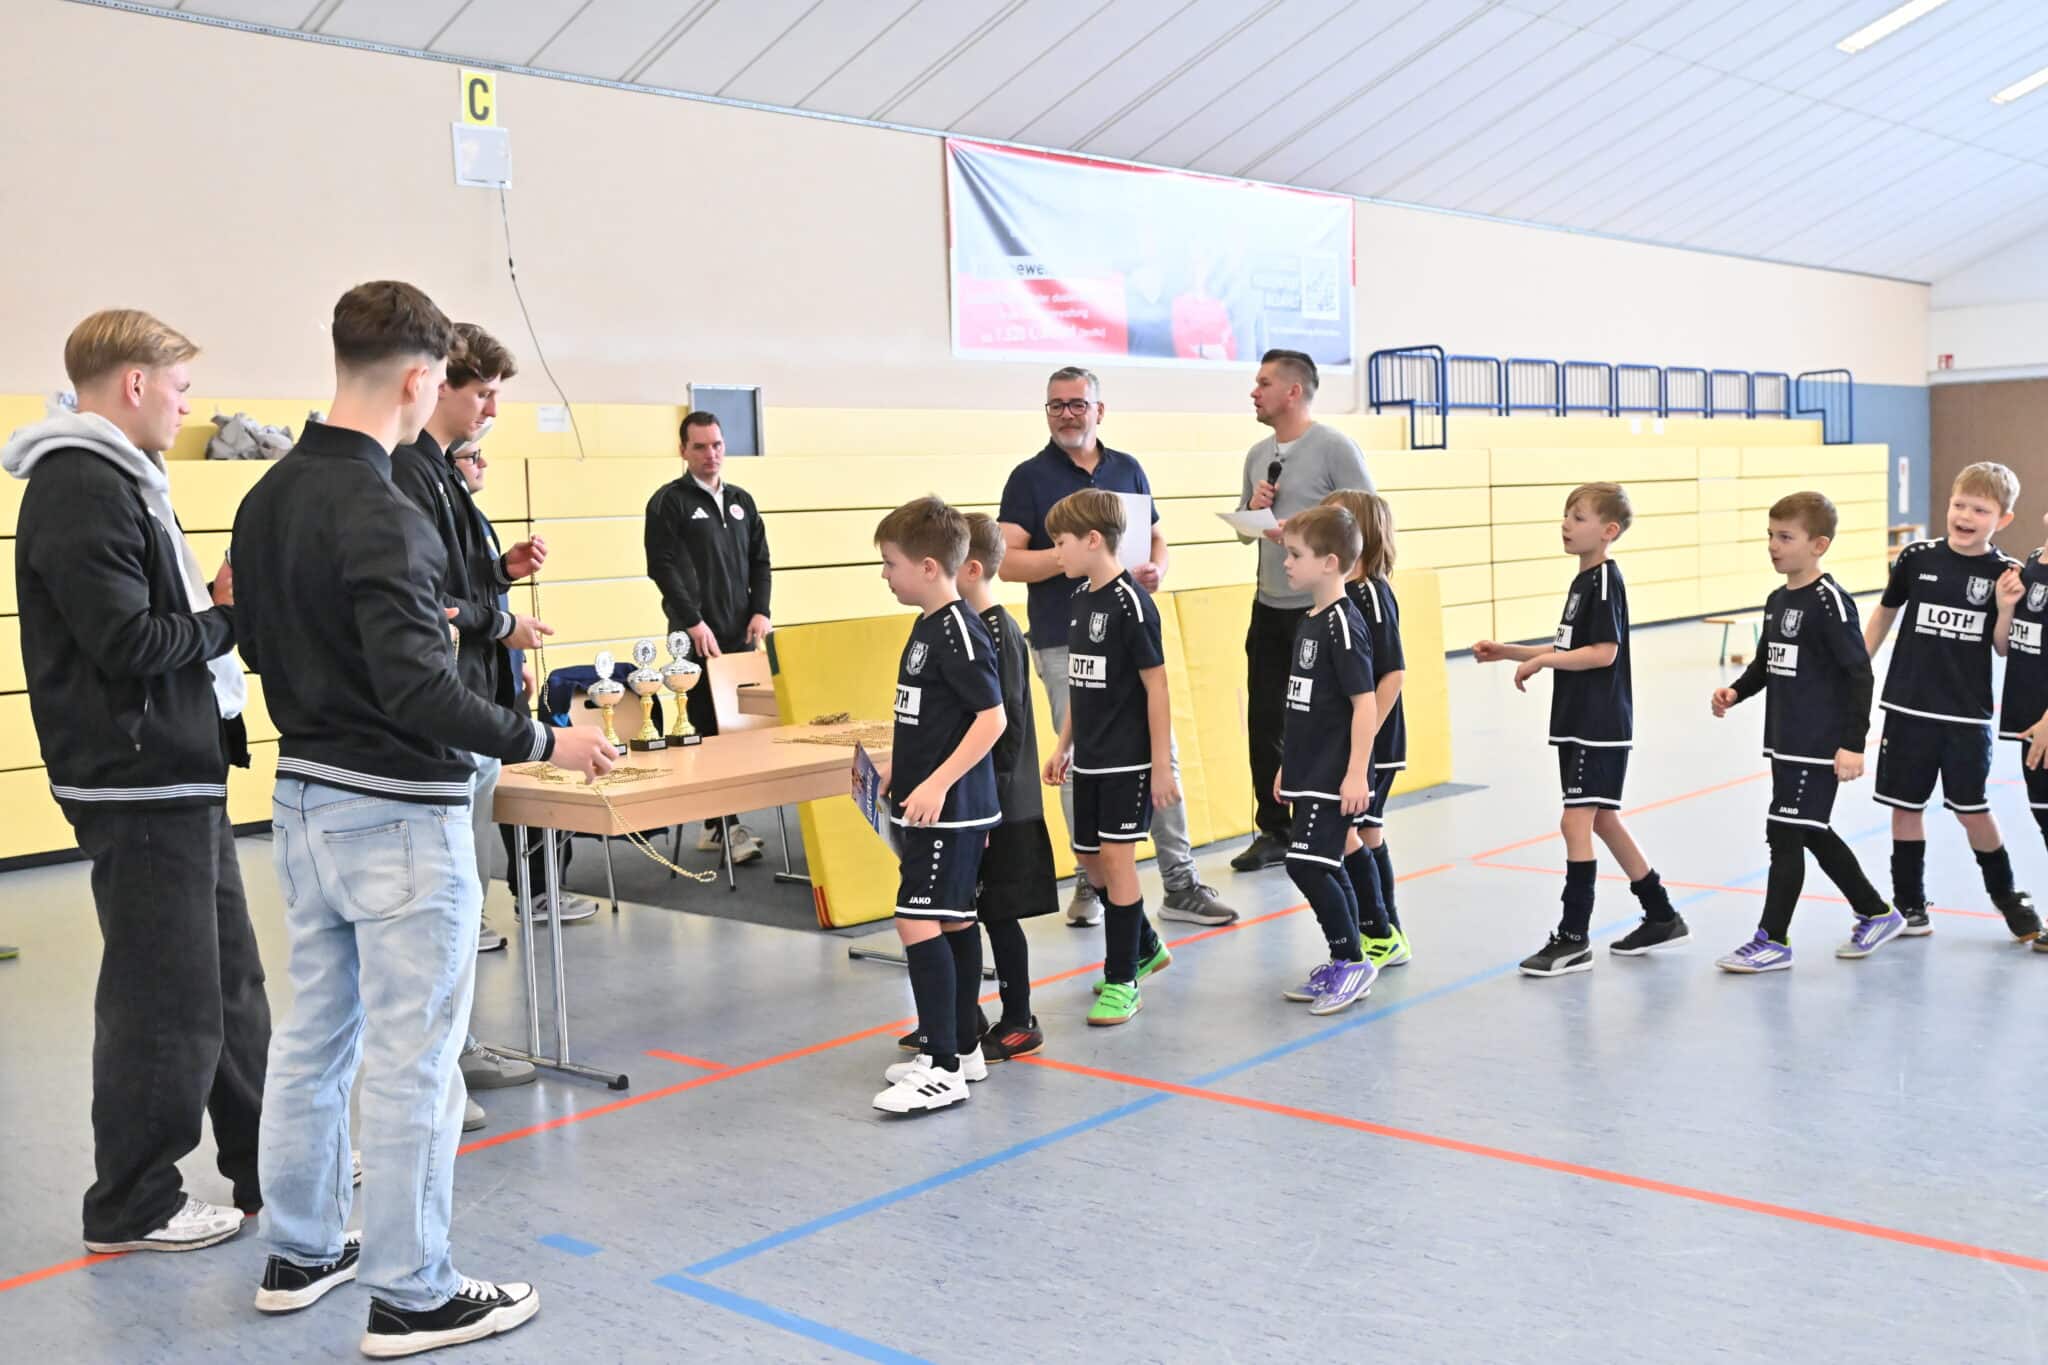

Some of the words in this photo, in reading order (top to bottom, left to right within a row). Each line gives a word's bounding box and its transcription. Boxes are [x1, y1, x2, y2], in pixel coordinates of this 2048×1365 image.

[469, 78, 489, 121] C
[1928, 608, 1975, 629] LOTH
[909, 896, 932, 905] JAKO
